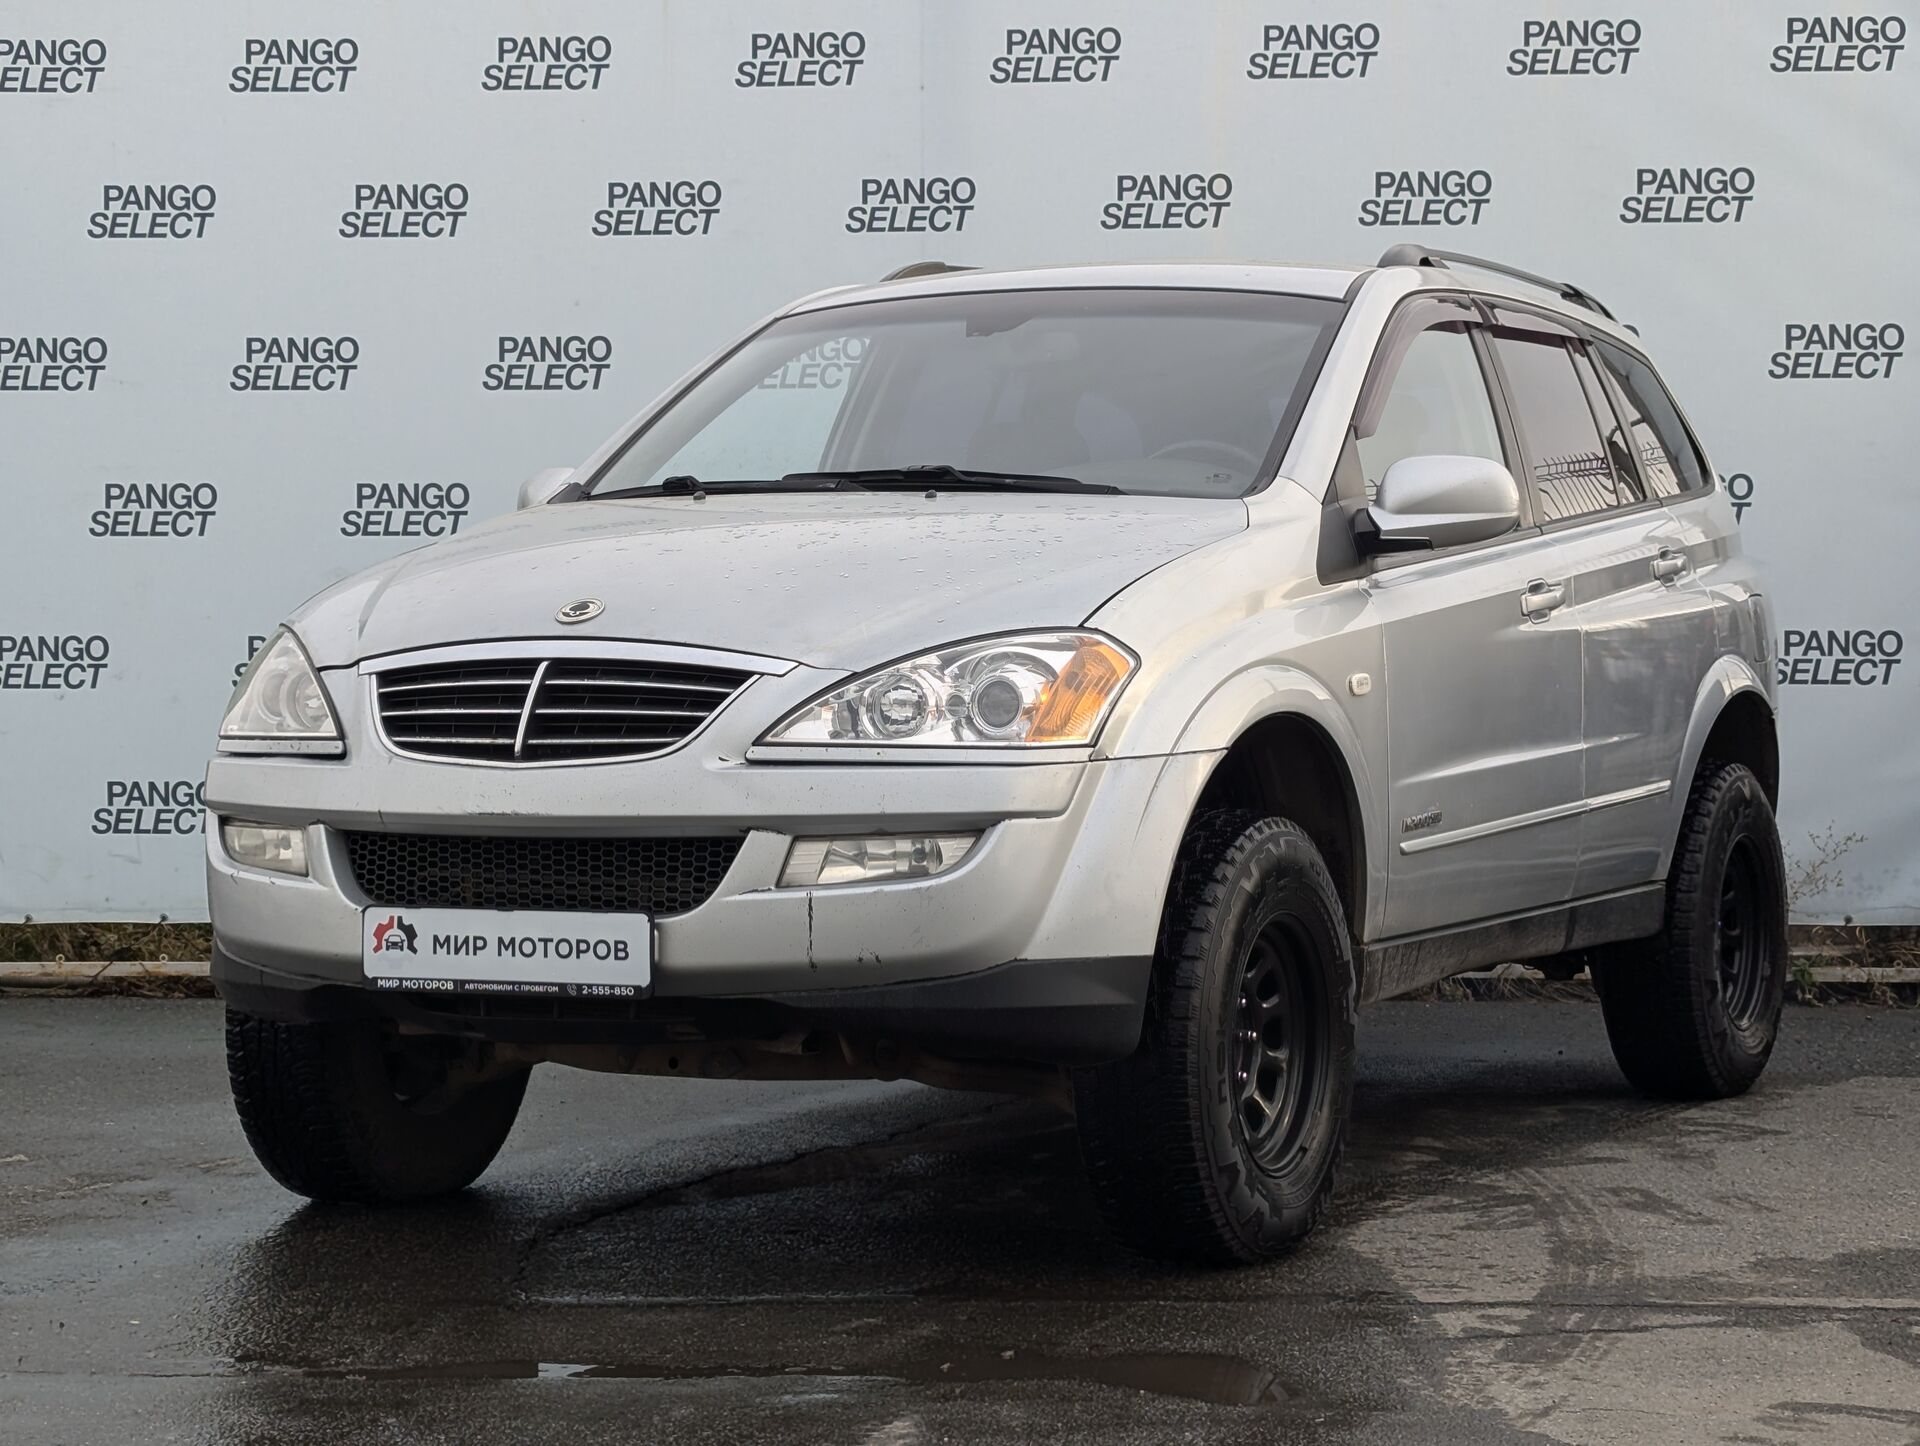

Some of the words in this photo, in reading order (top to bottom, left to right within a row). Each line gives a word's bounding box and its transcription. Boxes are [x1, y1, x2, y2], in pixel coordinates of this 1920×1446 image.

[1007, 28, 1121, 55] PANGO
[1264, 23, 1380, 50] PANGO
[1523, 20, 1641, 47] PANGO
[1787, 16, 1907, 44] PANGO
[246, 39, 358, 65] PANGO
[498, 36, 612, 63] PANGO
[752, 32, 866, 59] PANGO
[1770, 45, 1905, 72] SELECT
[735, 60, 864, 87] SELECT
[990, 56, 1119, 83] SELECT
[1246, 52, 1378, 79] SELECT
[1507, 48, 1639, 75] SELECT
[0, 67, 105, 93] ELECT
[229, 67, 356, 93] SELECT
[481, 64, 610, 91] SELECT
[608, 181, 722, 208] PANGO
[862, 177, 975, 204] PANGO
[1118, 174, 1232, 201] PANGO
[1376, 170, 1491, 197] PANGO
[1637, 167, 1755, 195] PANGO
[104, 185, 216, 211] PANGO
[355, 184, 468, 210] PANGO
[1620, 196, 1754, 223] SELECT
[87, 212, 214, 239] SELECT
[339, 212, 467, 238] SELECT
[592, 209, 720, 236] SELECT
[846, 206, 974, 233] SELECT
[1101, 202, 1230, 229] SELECT
[1358, 199, 1490, 226] SELECT
[0, 337, 107, 364] PANGO
[247, 337, 359, 363] PANGO
[499, 336, 612, 362] PANGO
[1786, 324, 1905, 351] PANGO
[0, 365, 106, 391] ELECT
[230, 365, 358, 391] SELECT
[482, 364, 610, 390] SELECT
[1768, 352, 1903, 379] SELECT
[104, 483, 217, 509] PANGO
[357, 483, 470, 509] PANGO
[89, 510, 216, 537] SELECT
[340, 510, 468, 537] SELECT
[0, 635, 109, 662] PANGO
[1784, 630, 1903, 657] PANGO
[0, 663, 108, 689] ELECT
[432, 934, 488, 956] МИР
[497, 936, 630, 961] МОТОРОВ
[377, 978, 400, 988] МИР
[402, 979, 454, 990] МОТОРОВ
[464, 983, 513, 991] АВТОМОБИЛИ
[520, 984, 559, 993] ПРОБЕГОМ
[582, 985, 635, 996] 2-555-850
